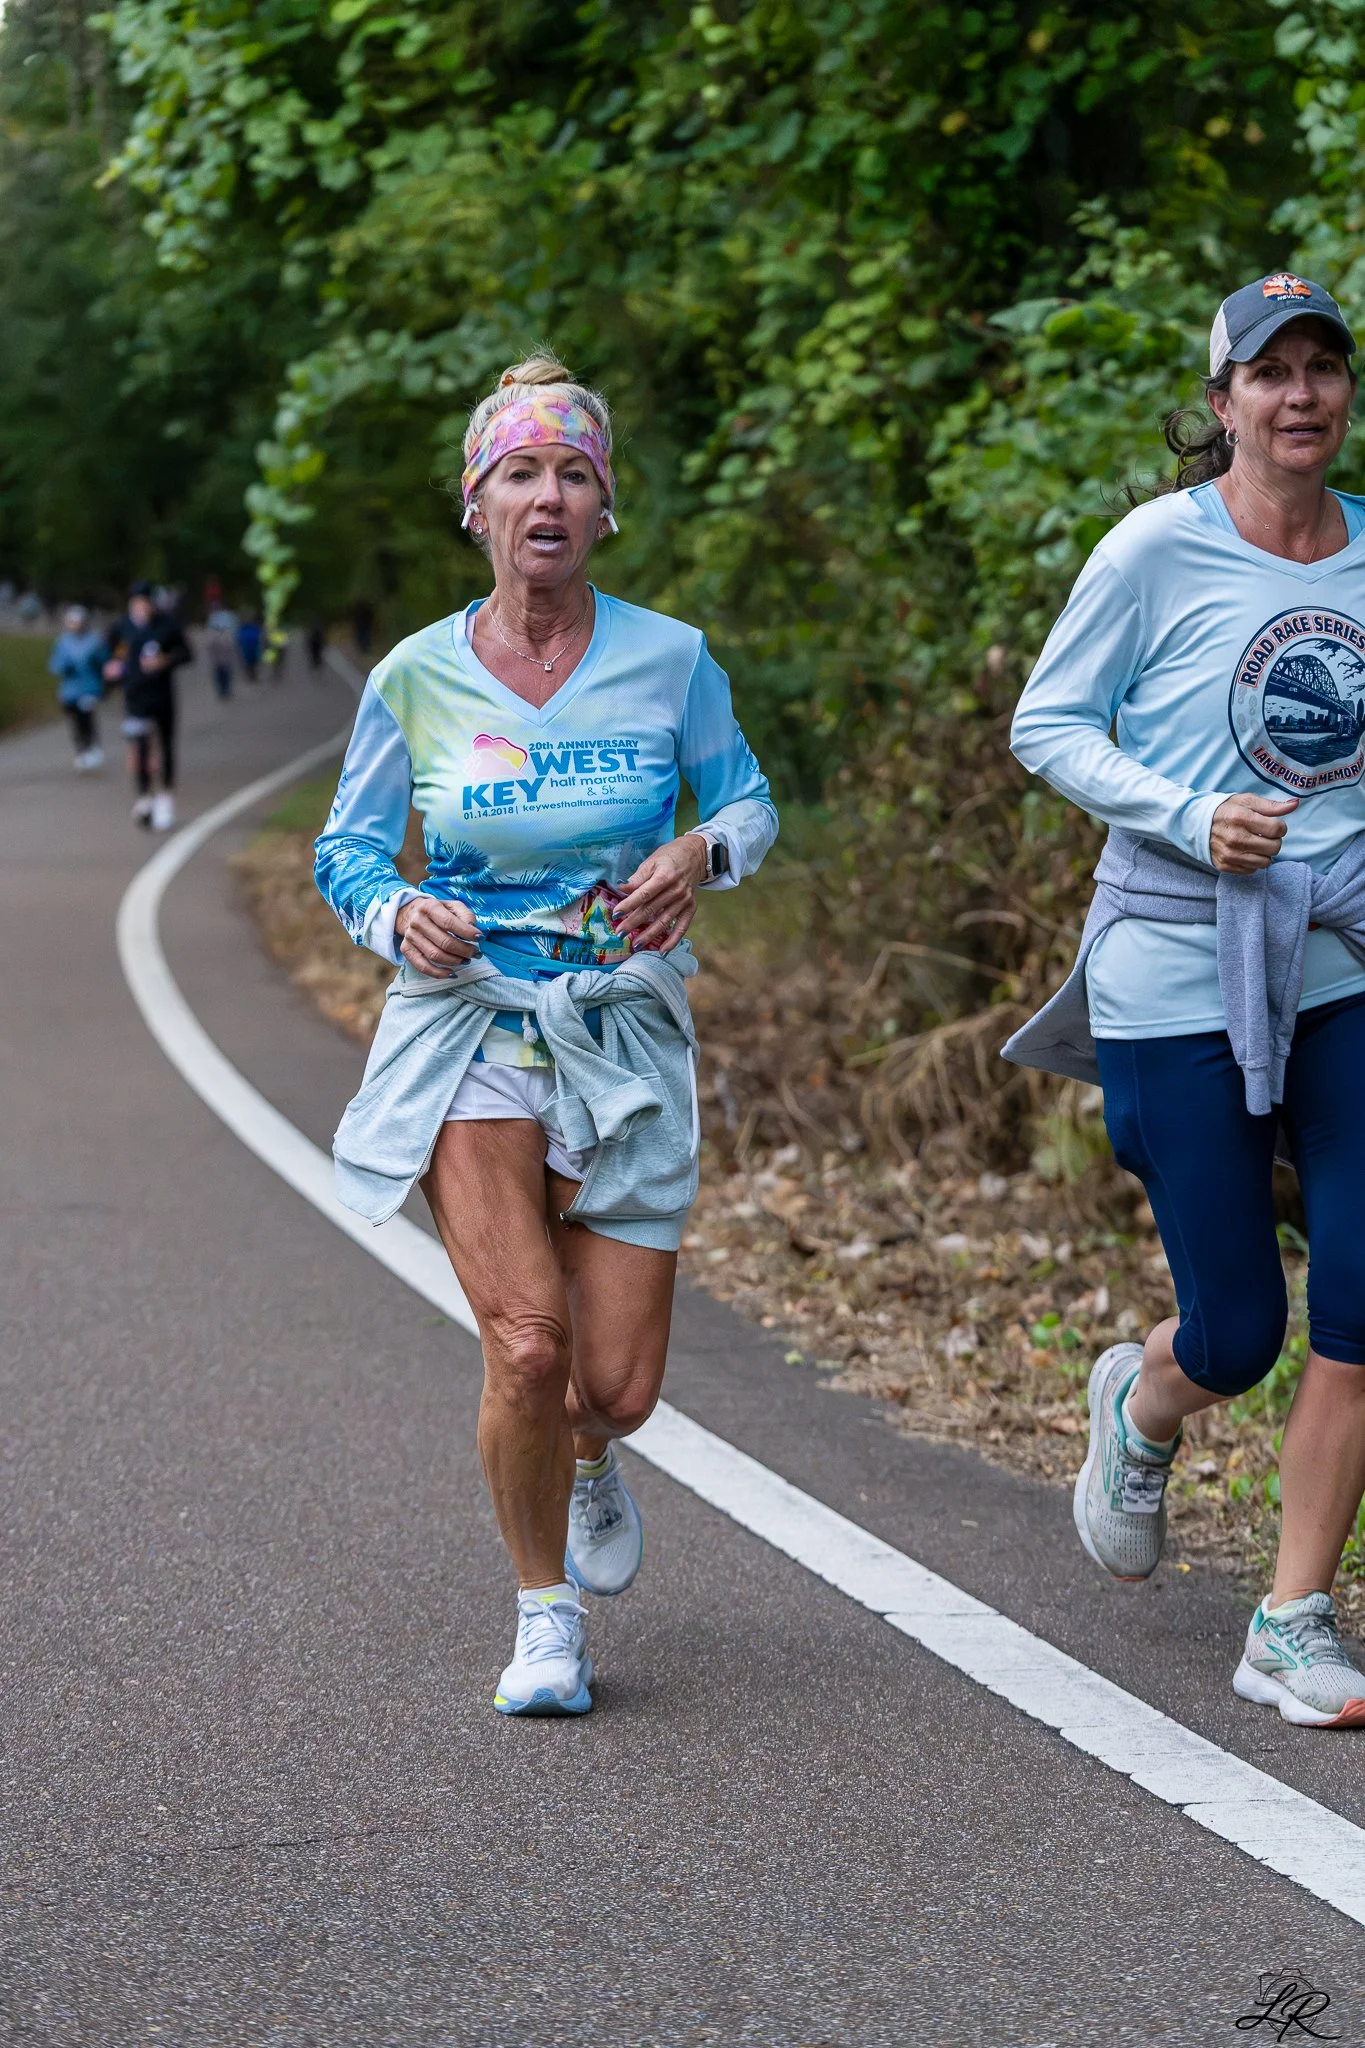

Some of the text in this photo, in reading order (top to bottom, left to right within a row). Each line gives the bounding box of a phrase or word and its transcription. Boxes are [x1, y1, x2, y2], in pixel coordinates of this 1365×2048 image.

[1240, 615, 1365, 686] ROAD RACE SERIES
[529, 739, 639, 751] 20th ANNIVERSARY
[1253, 748, 1280, 773] LANE
[1277, 766, 1318, 788] PURSER
[462, 749, 640, 811] KEY WEST
[550, 774, 643, 788] half marathon
[586, 786, 597, 796] &
[463, 807, 514, 820] 01.14.2018
[522, 798, 649, 812] keywesthalfmarathon.com
